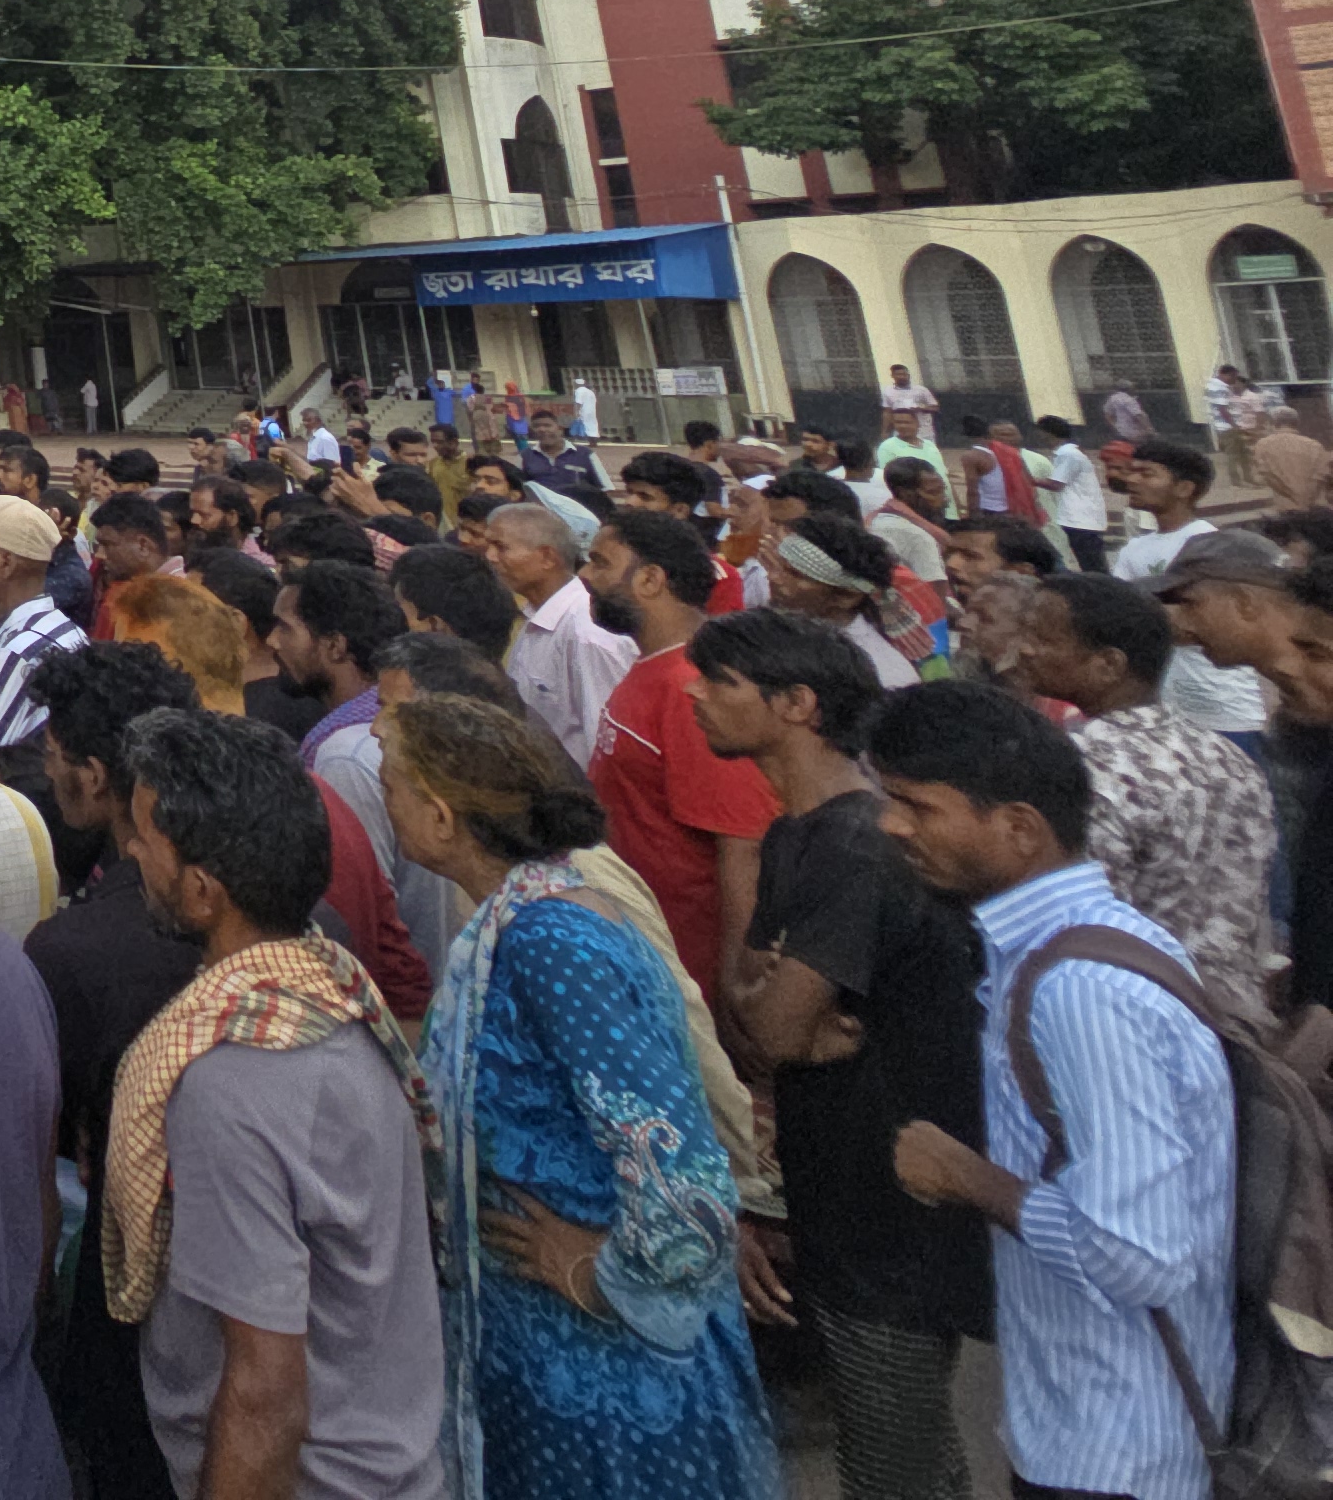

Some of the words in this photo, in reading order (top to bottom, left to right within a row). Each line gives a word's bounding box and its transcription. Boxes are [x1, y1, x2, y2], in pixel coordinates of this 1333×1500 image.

[421, 271, 474, 299] জুতা
[481, 263, 584, 291] রাখার
[591, 259, 655, 284] ঘর
